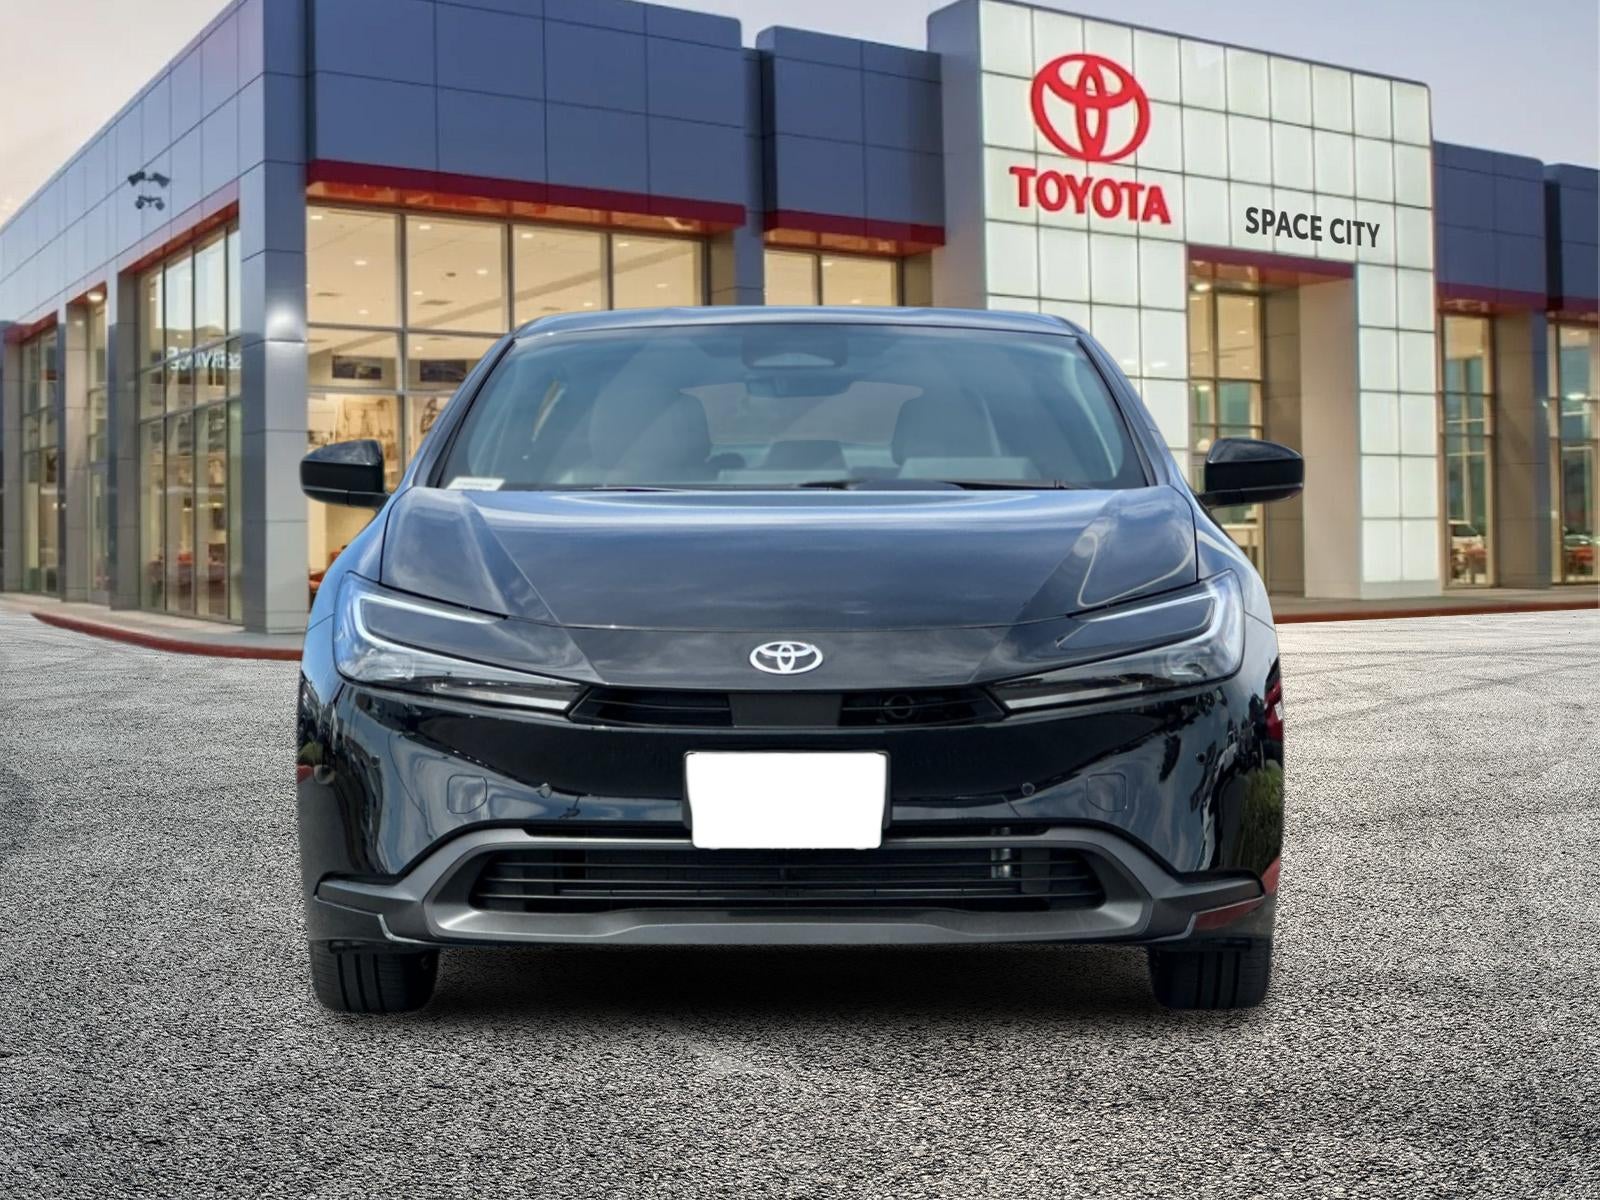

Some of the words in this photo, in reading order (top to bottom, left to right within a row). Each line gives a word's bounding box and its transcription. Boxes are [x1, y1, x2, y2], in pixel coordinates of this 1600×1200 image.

[1009, 166, 1171, 224] TOYOTA
[1245, 206, 1323, 241] SPACE
[1329, 219, 1381, 248] CITY
